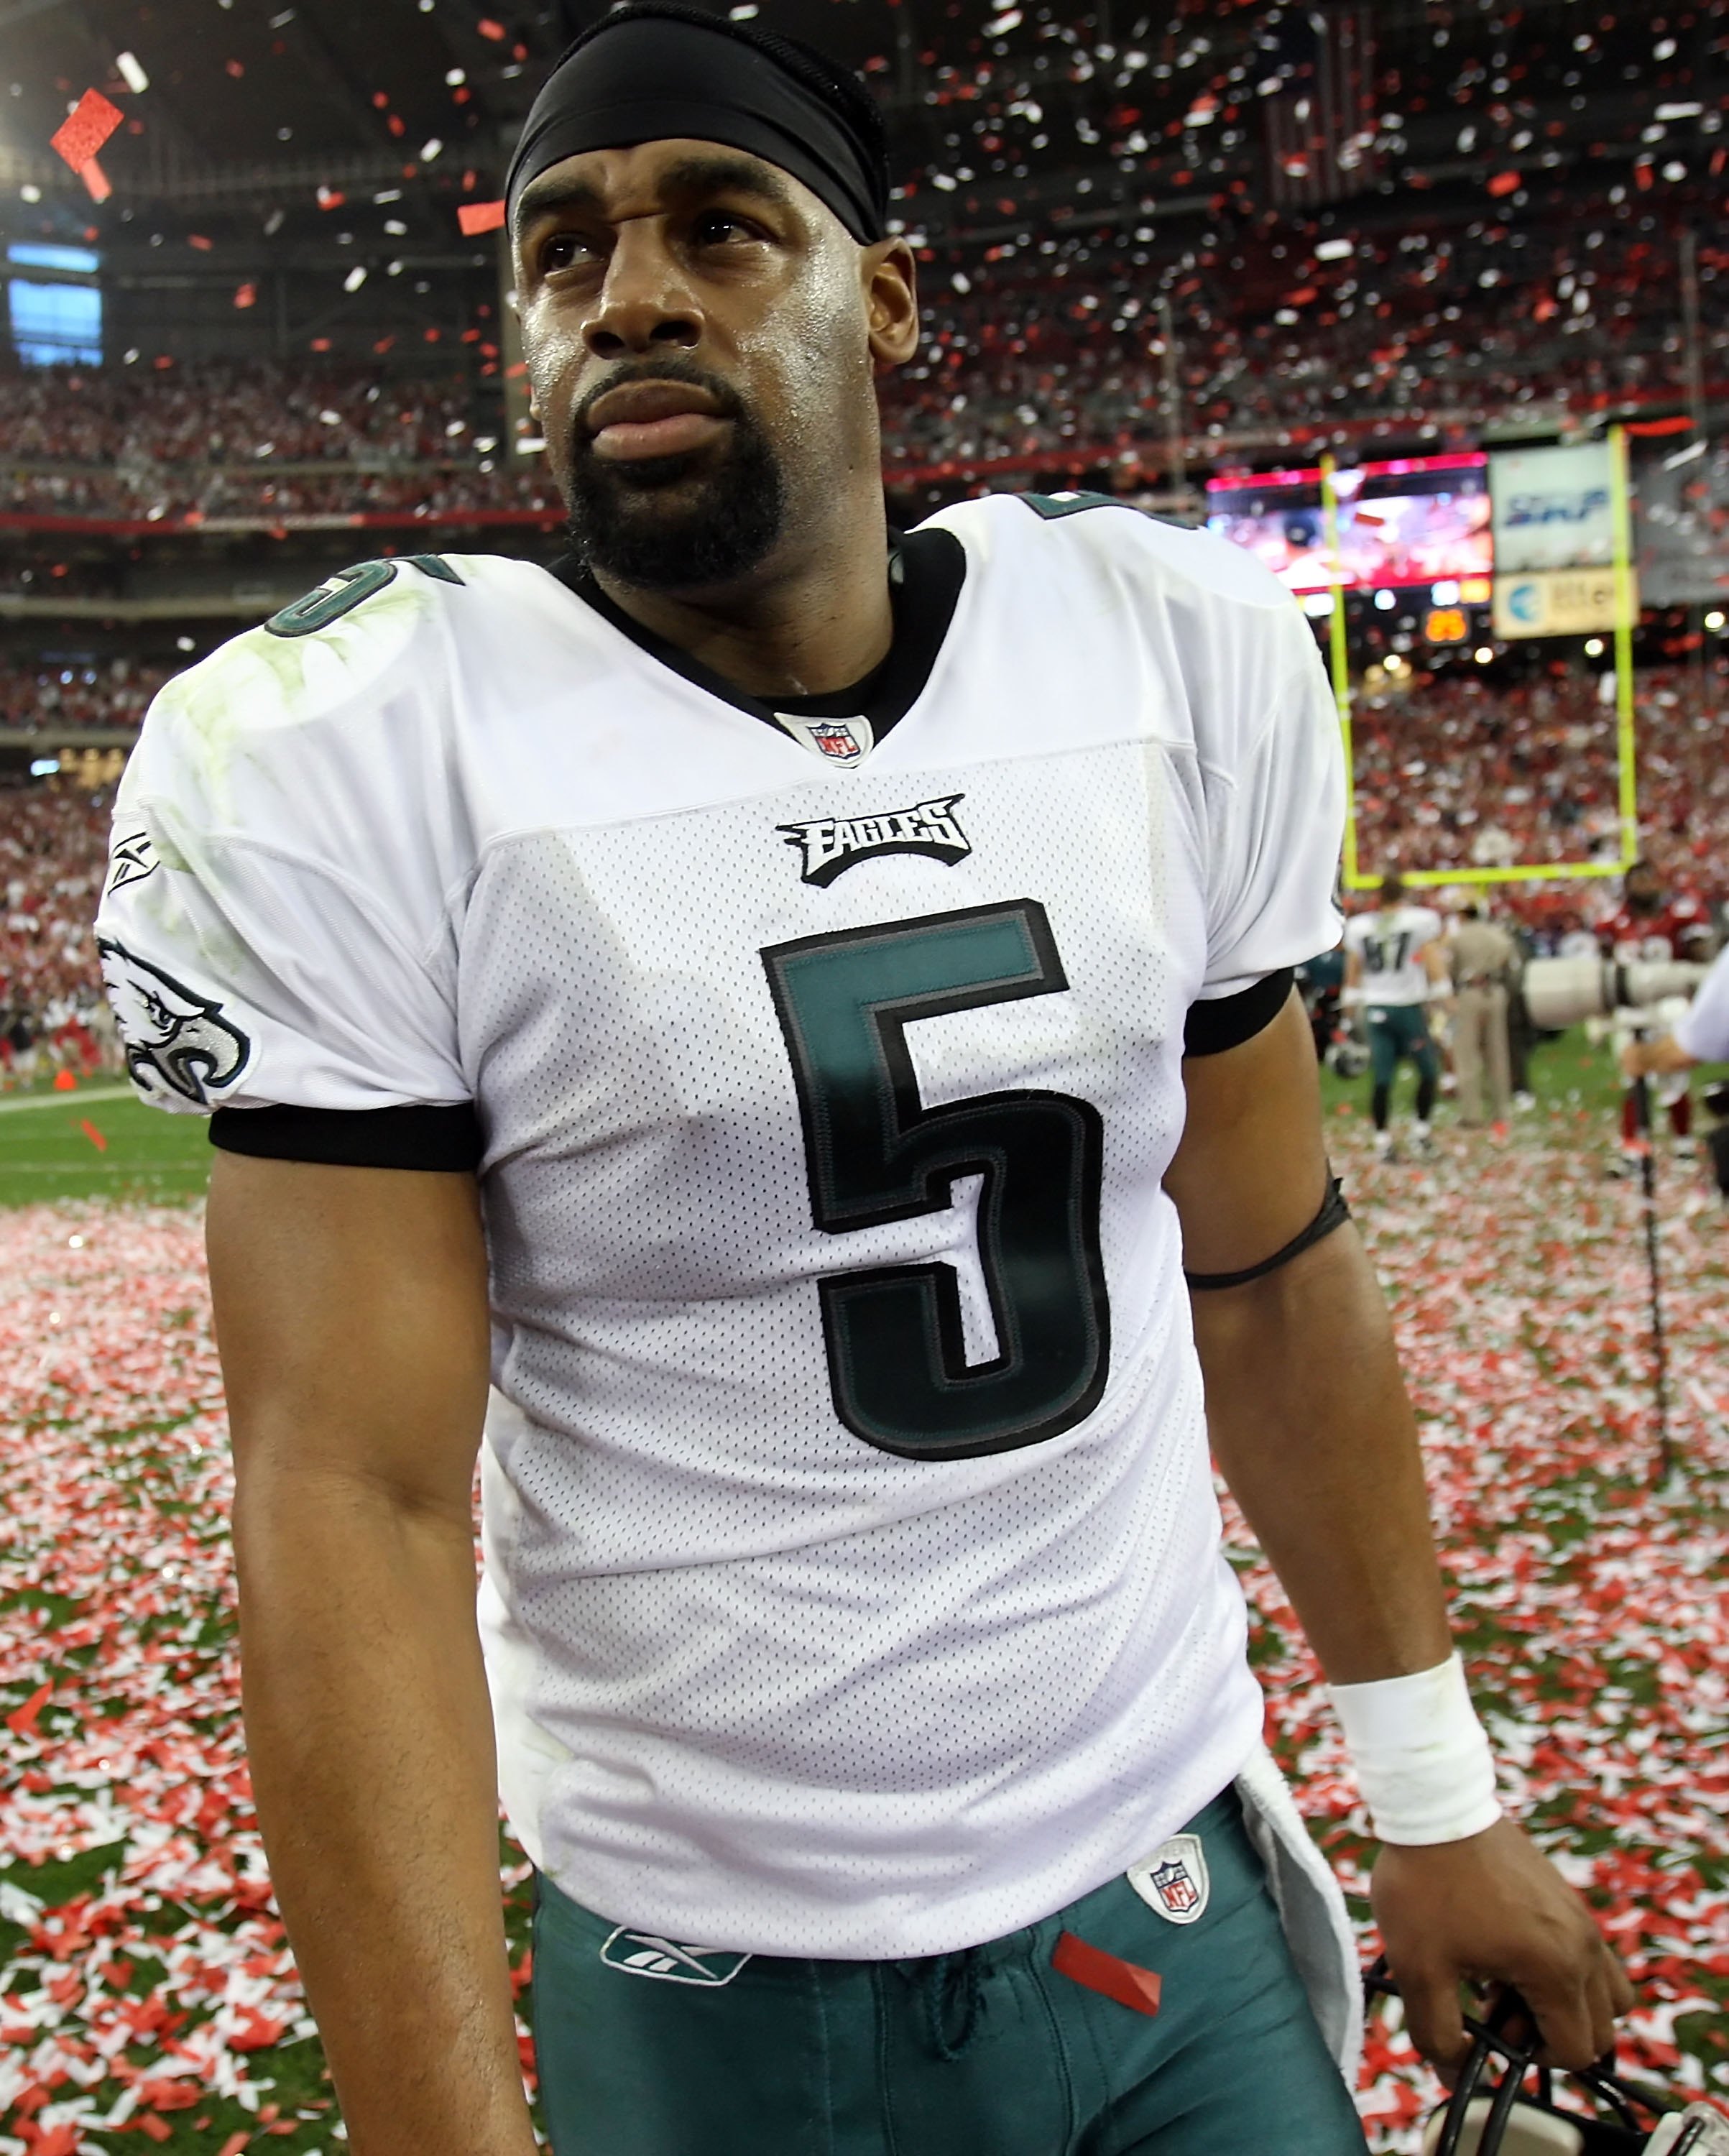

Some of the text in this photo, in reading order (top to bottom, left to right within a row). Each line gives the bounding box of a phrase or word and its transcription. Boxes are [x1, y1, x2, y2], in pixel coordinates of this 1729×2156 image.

[817, 735, 859, 757] NFL
[780, 794, 972, 885] EAGLES
[760, 898, 1111, 1462] 5
[1161, 1876, 1198, 1910] NFL
